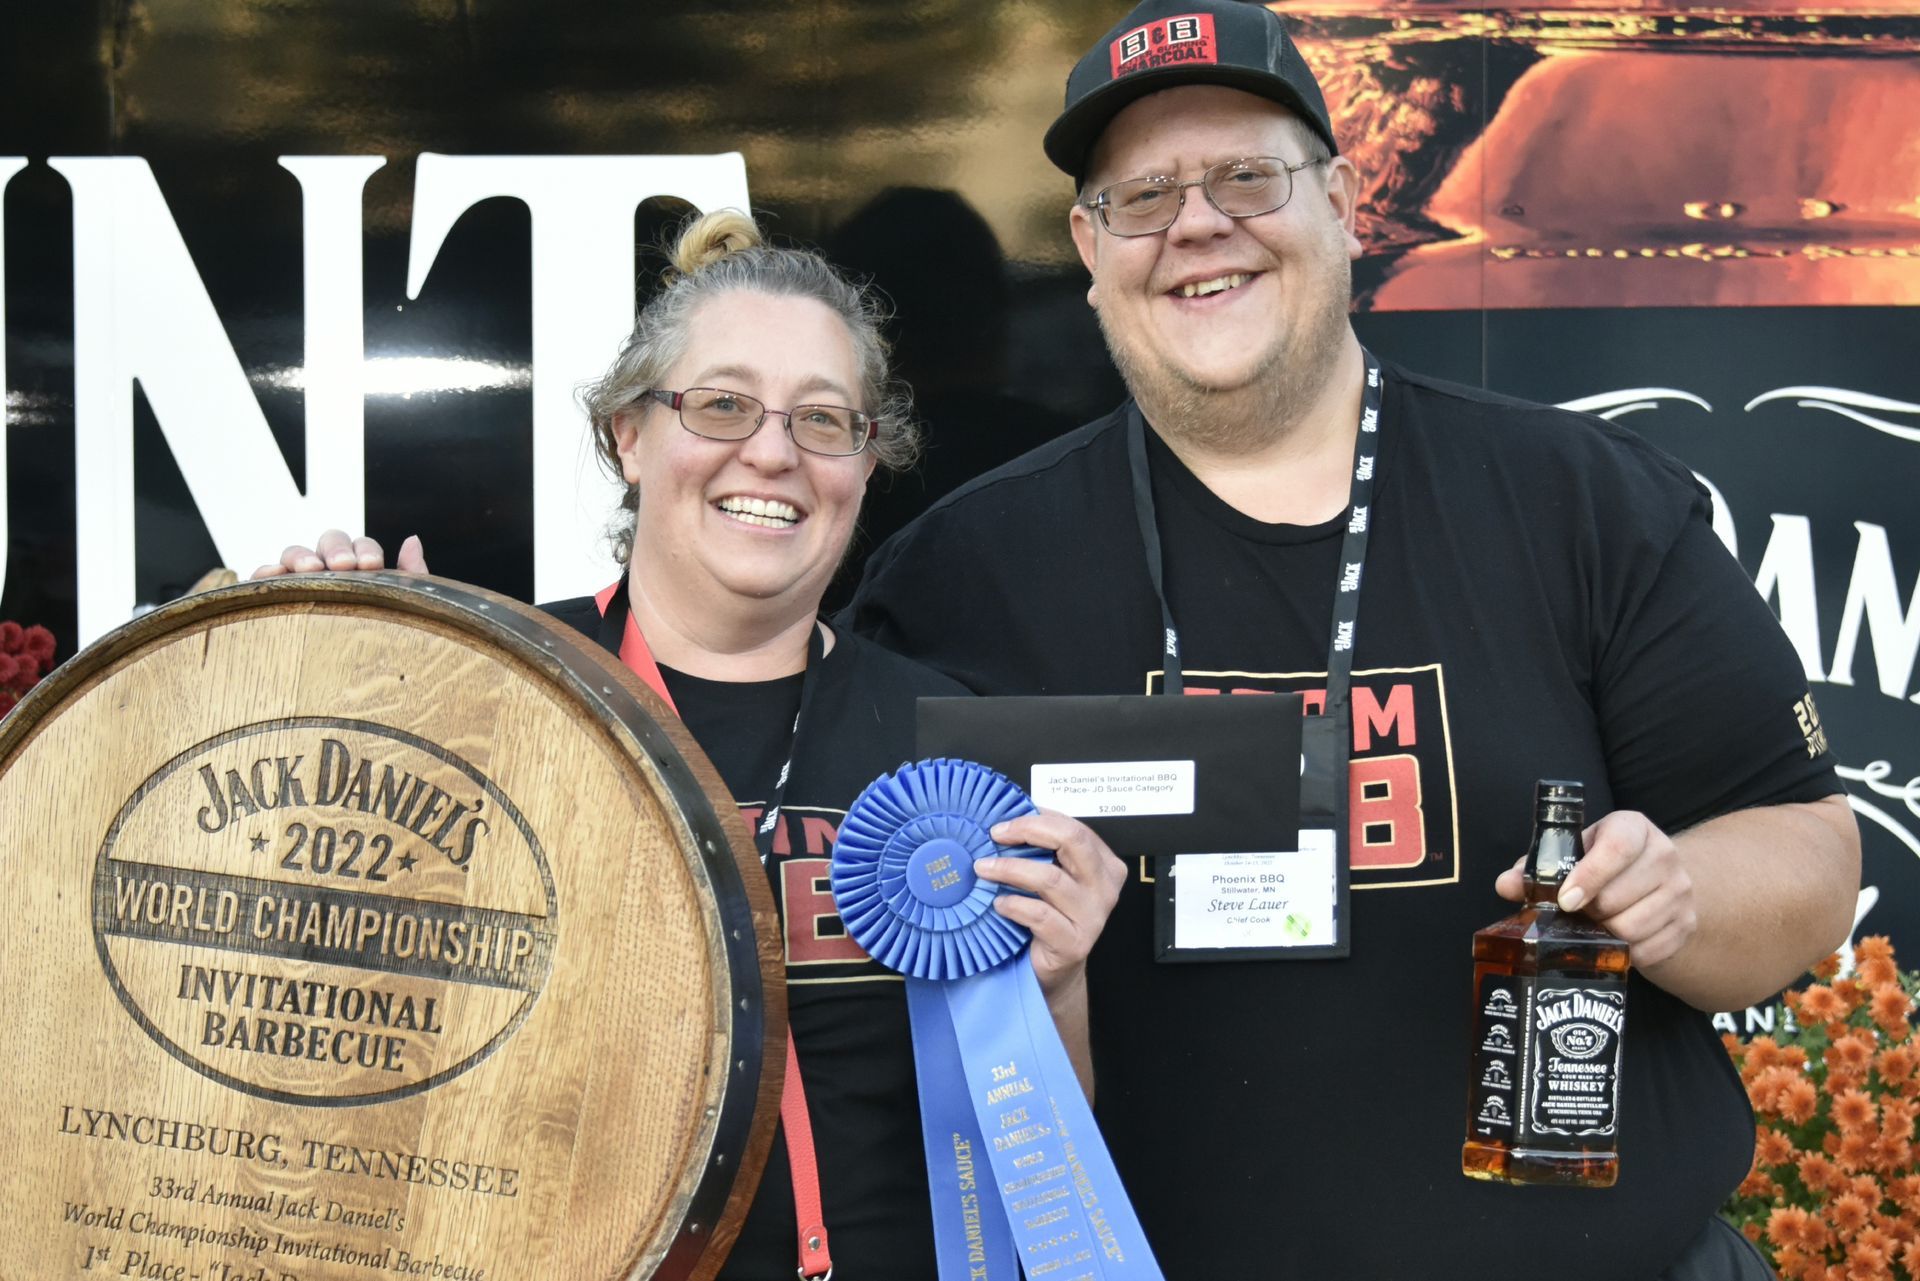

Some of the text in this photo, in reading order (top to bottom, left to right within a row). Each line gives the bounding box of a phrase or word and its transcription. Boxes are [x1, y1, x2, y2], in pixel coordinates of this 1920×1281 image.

[1049, 773, 1178, 784] Jack Daniel's Invitational BBQ
[1092, 785, 1104, 793] JD
[1106, 784, 1133, 793] Sauce
[1136, 784, 1174, 793] Category
[197, 738, 491, 868] JACK DANIEL'S
[280, 822, 394, 882] 2022
[1212, 873, 1285, 884] Phoenix BBQ
[1221, 886, 1260, 894] Stillwater,
[1208, 898, 1288, 912] Steve Lauer
[1227, 916, 1248, 924] Chief
[114, 876, 535, 973] WORLD CHAMPIONSHIP
[177, 964, 442, 1034] INVITATIONAL
[1536, 1000, 1572, 1030] JACK
[1573, 993, 1624, 1033] DANIEL'S
[201, 1011, 406, 1073] BARBECUE
[991, 1061, 1017, 1082] 33rd
[1548, 1057, 1607, 1074] Tennessee
[987, 1077, 1034, 1106] ANNUAL
[1548, 1081, 1606, 1092] WHISKEY
[58, 1105, 519, 1198] LYNCHBURG, TENNESSEE
[149, 1176, 406, 1232] 33rd Annual Jack Daniel's
[63, 1201, 486, 1281] World Championship Invitational Barbecue
[961, 1194, 985, 1262] DANIEL'S
